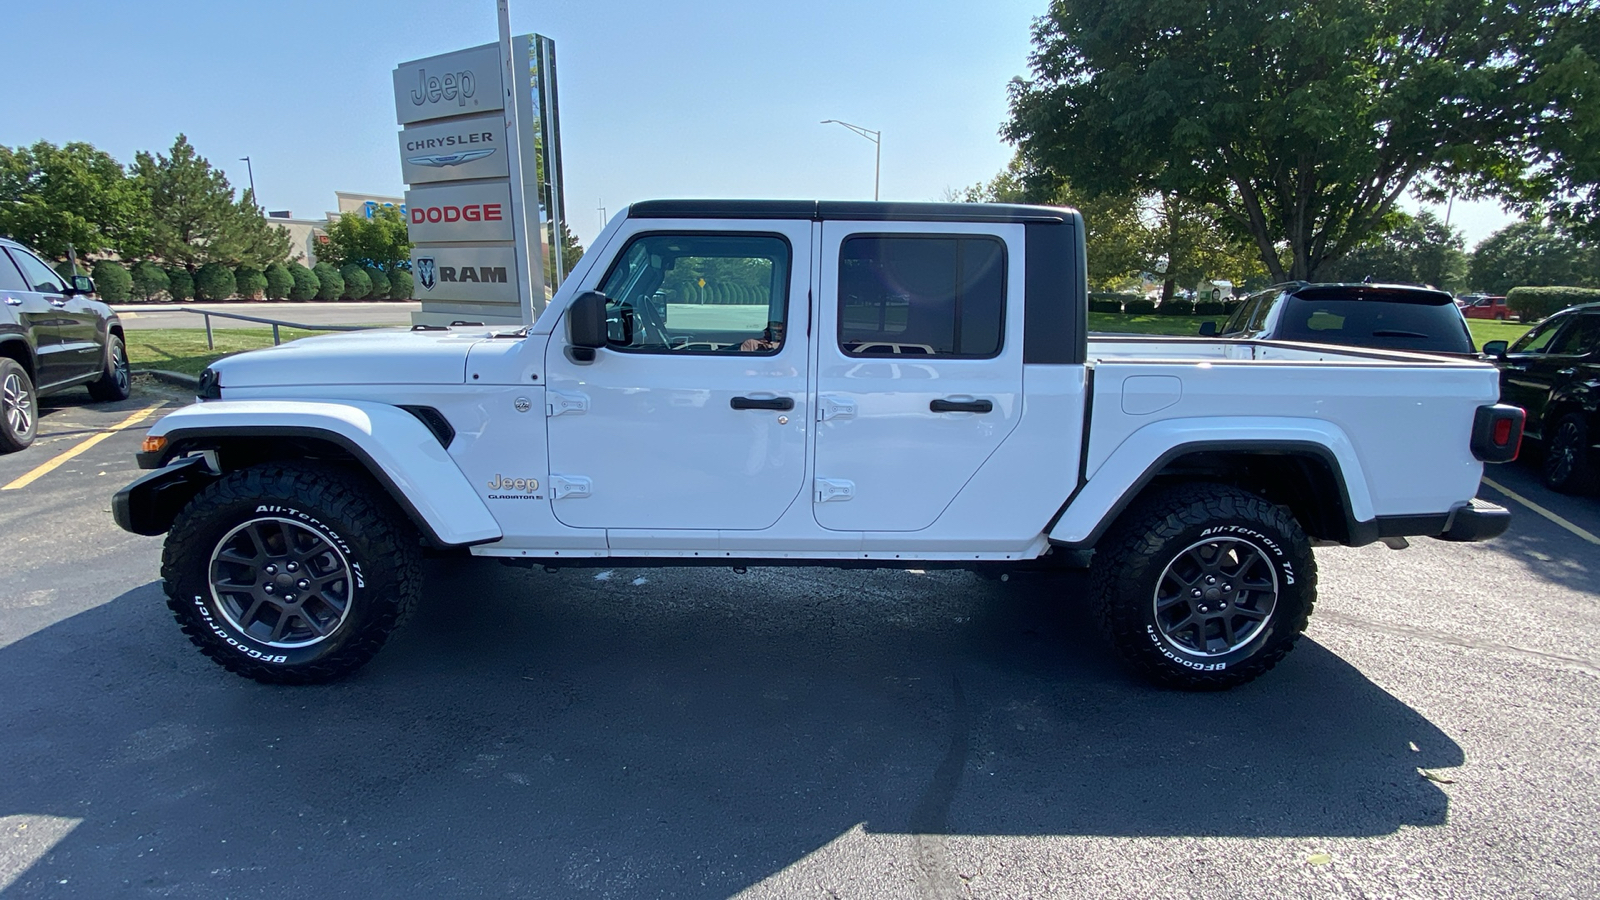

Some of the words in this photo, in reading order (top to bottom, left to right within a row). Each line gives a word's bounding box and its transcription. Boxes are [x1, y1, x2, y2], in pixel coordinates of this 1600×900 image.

[411, 69, 476, 106] Jeep
[406, 132, 493, 151] CHRYSLER
[411, 203, 502, 224] DODGE
[439, 266, 507, 283] RAM
[488, 474, 539, 494] Jeep
[255, 504, 351, 554] All-Terrain
[352, 562, 365, 589] T/A
[1199, 525, 1284, 556] All-Terrain
[1282, 561, 1295, 585] T/A
[194, 595, 288, 664] BFGoodrich
[1146, 624, 1227, 671] BFGoodrich
